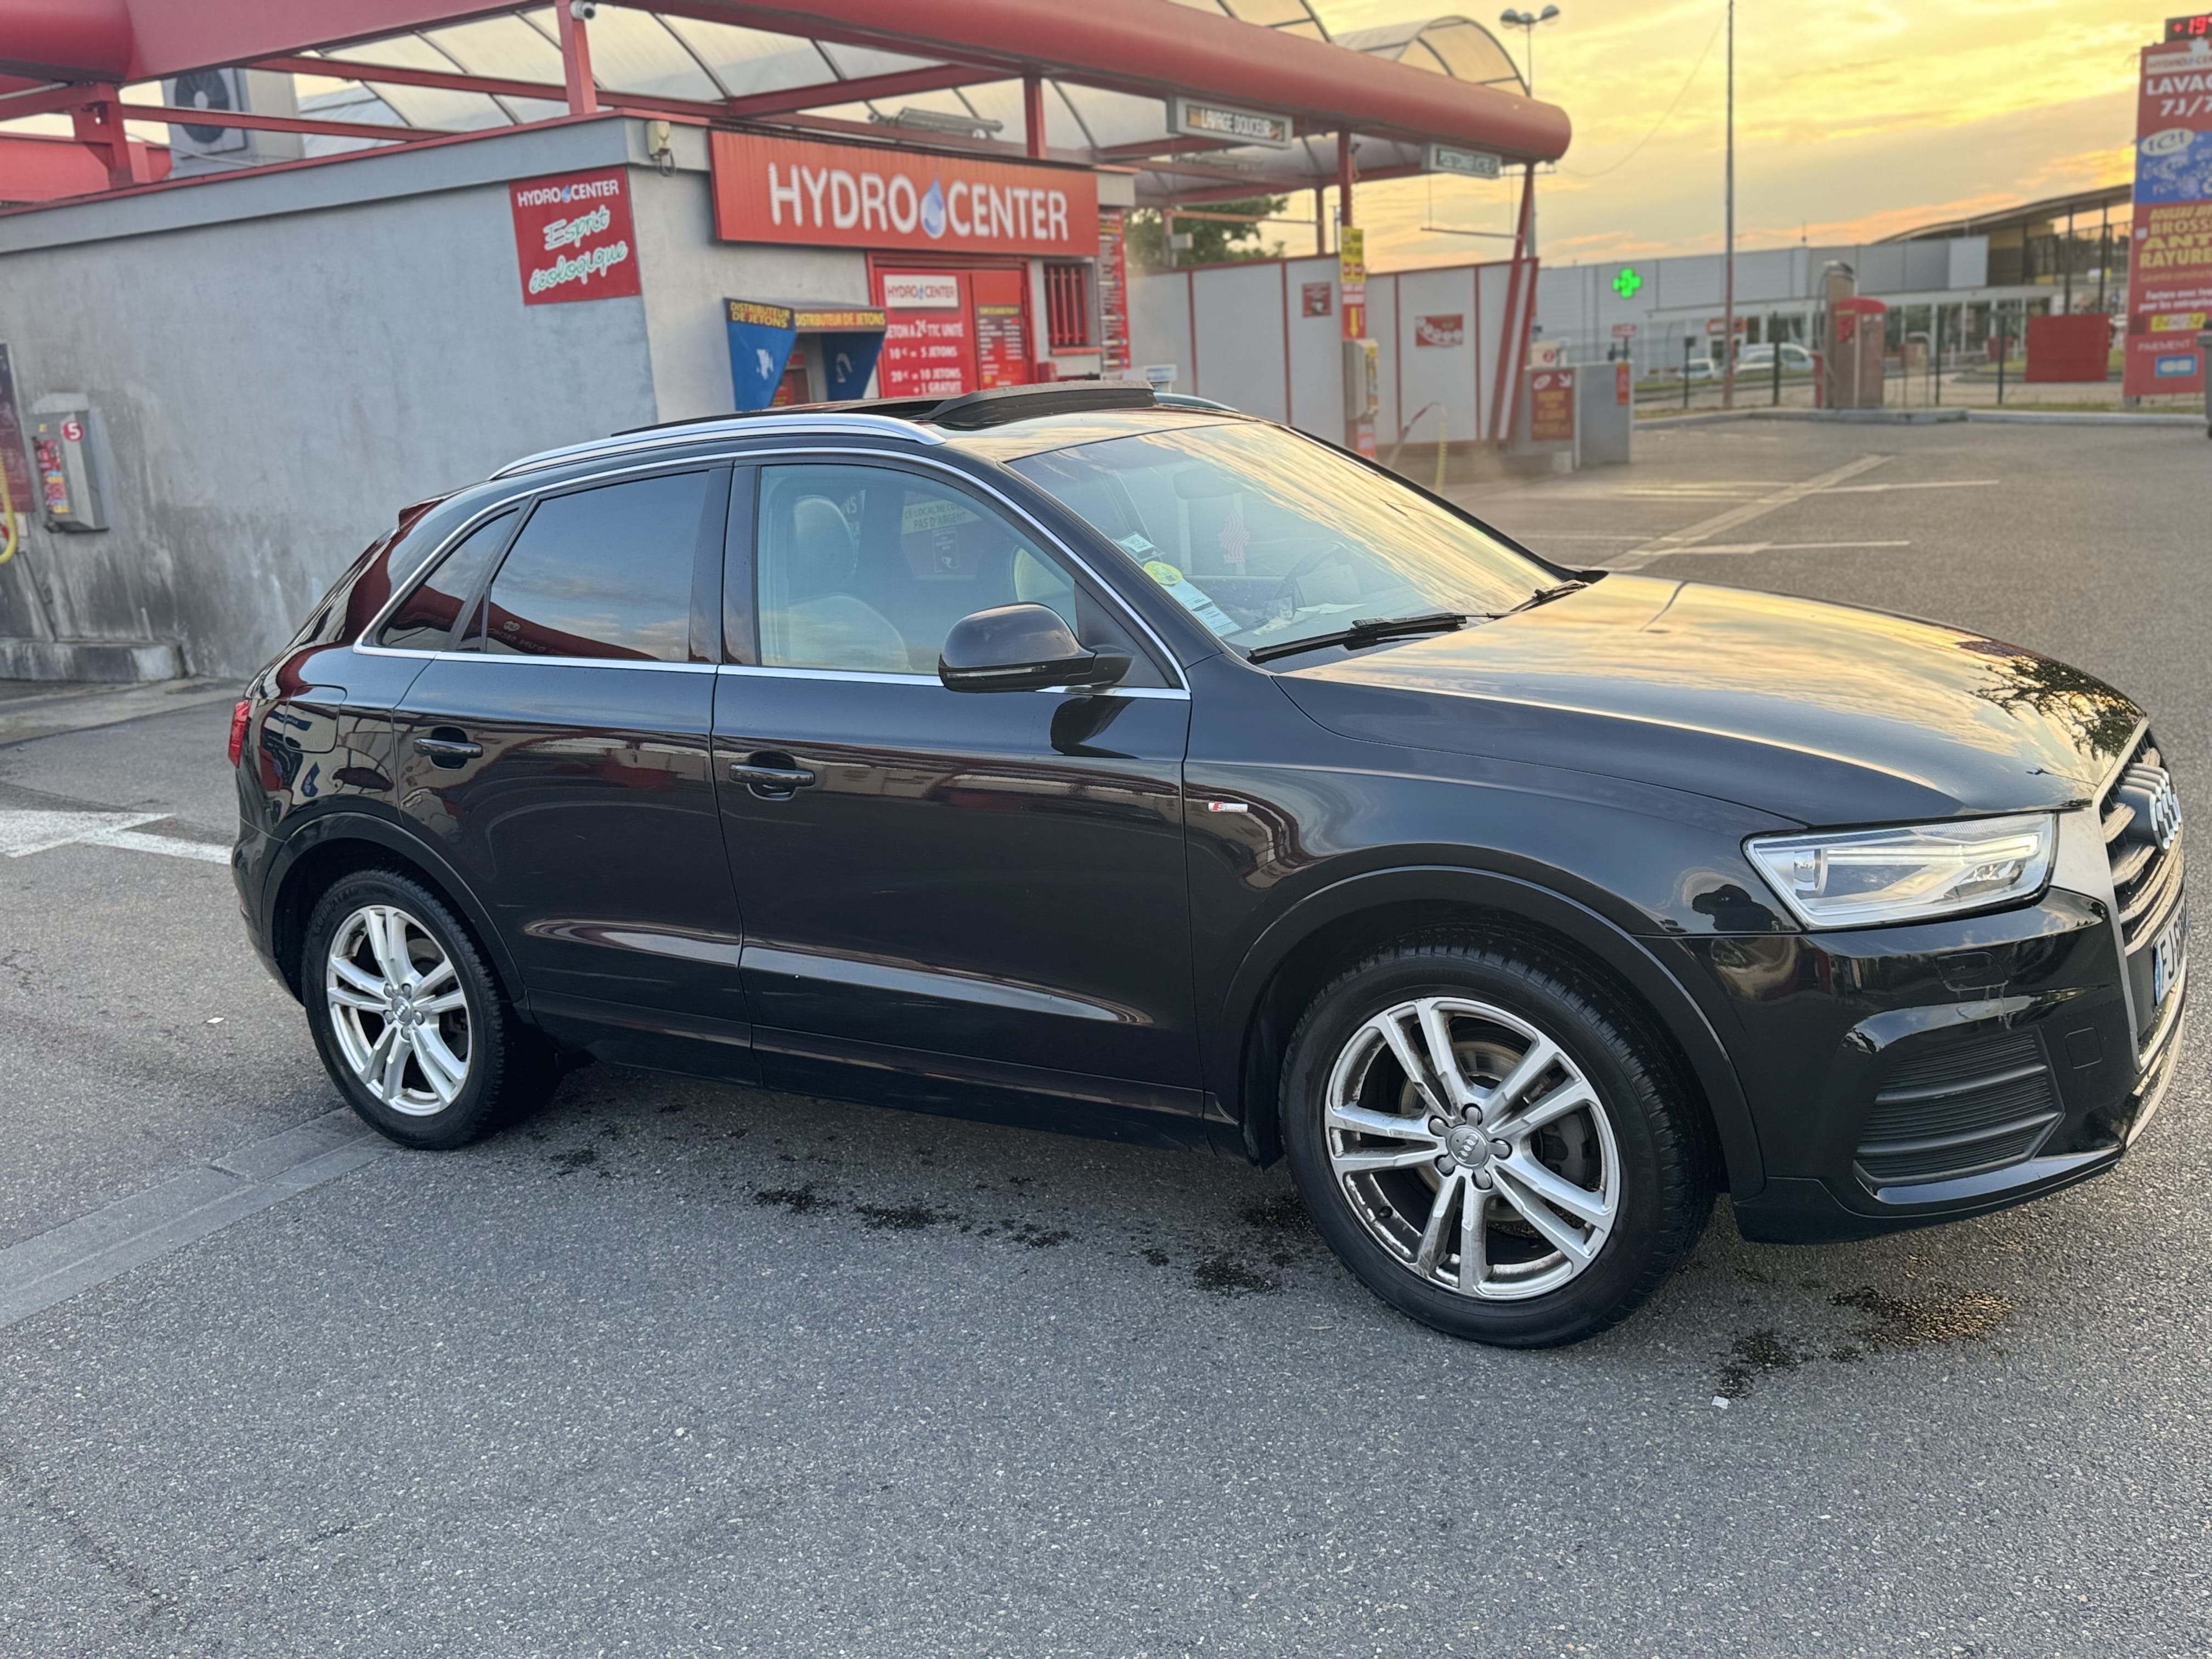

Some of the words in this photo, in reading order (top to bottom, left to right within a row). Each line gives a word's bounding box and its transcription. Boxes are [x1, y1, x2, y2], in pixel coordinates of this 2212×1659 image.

[517, 187, 561, 207] HYDRO
[571, 179, 619, 200] CENTER
[768, 163, 917, 234] HYDRO
[948, 180, 1069, 241] CENTER
[543, 204, 611, 251] Esprit
[2151, 218, 2212, 235] BROSS
[528, 240, 629, 294] écologique
[887, 285, 918, 298] HYDRO
[925, 285, 955, 298] CENTER
[730, 302, 791, 320] DISTRIBUTEUR
[732, 311, 744, 322] DE
[747, 313, 788, 328] JETONS
[795, 313, 843, 326] DISTRIBUTEUR
[844, 313, 854, 325] DE
[856, 312, 885, 325] JETONS
[928, 345, 958, 358] JETONS
[932, 367, 962, 380] JETONS
[68, 424, 81, 439] 5
